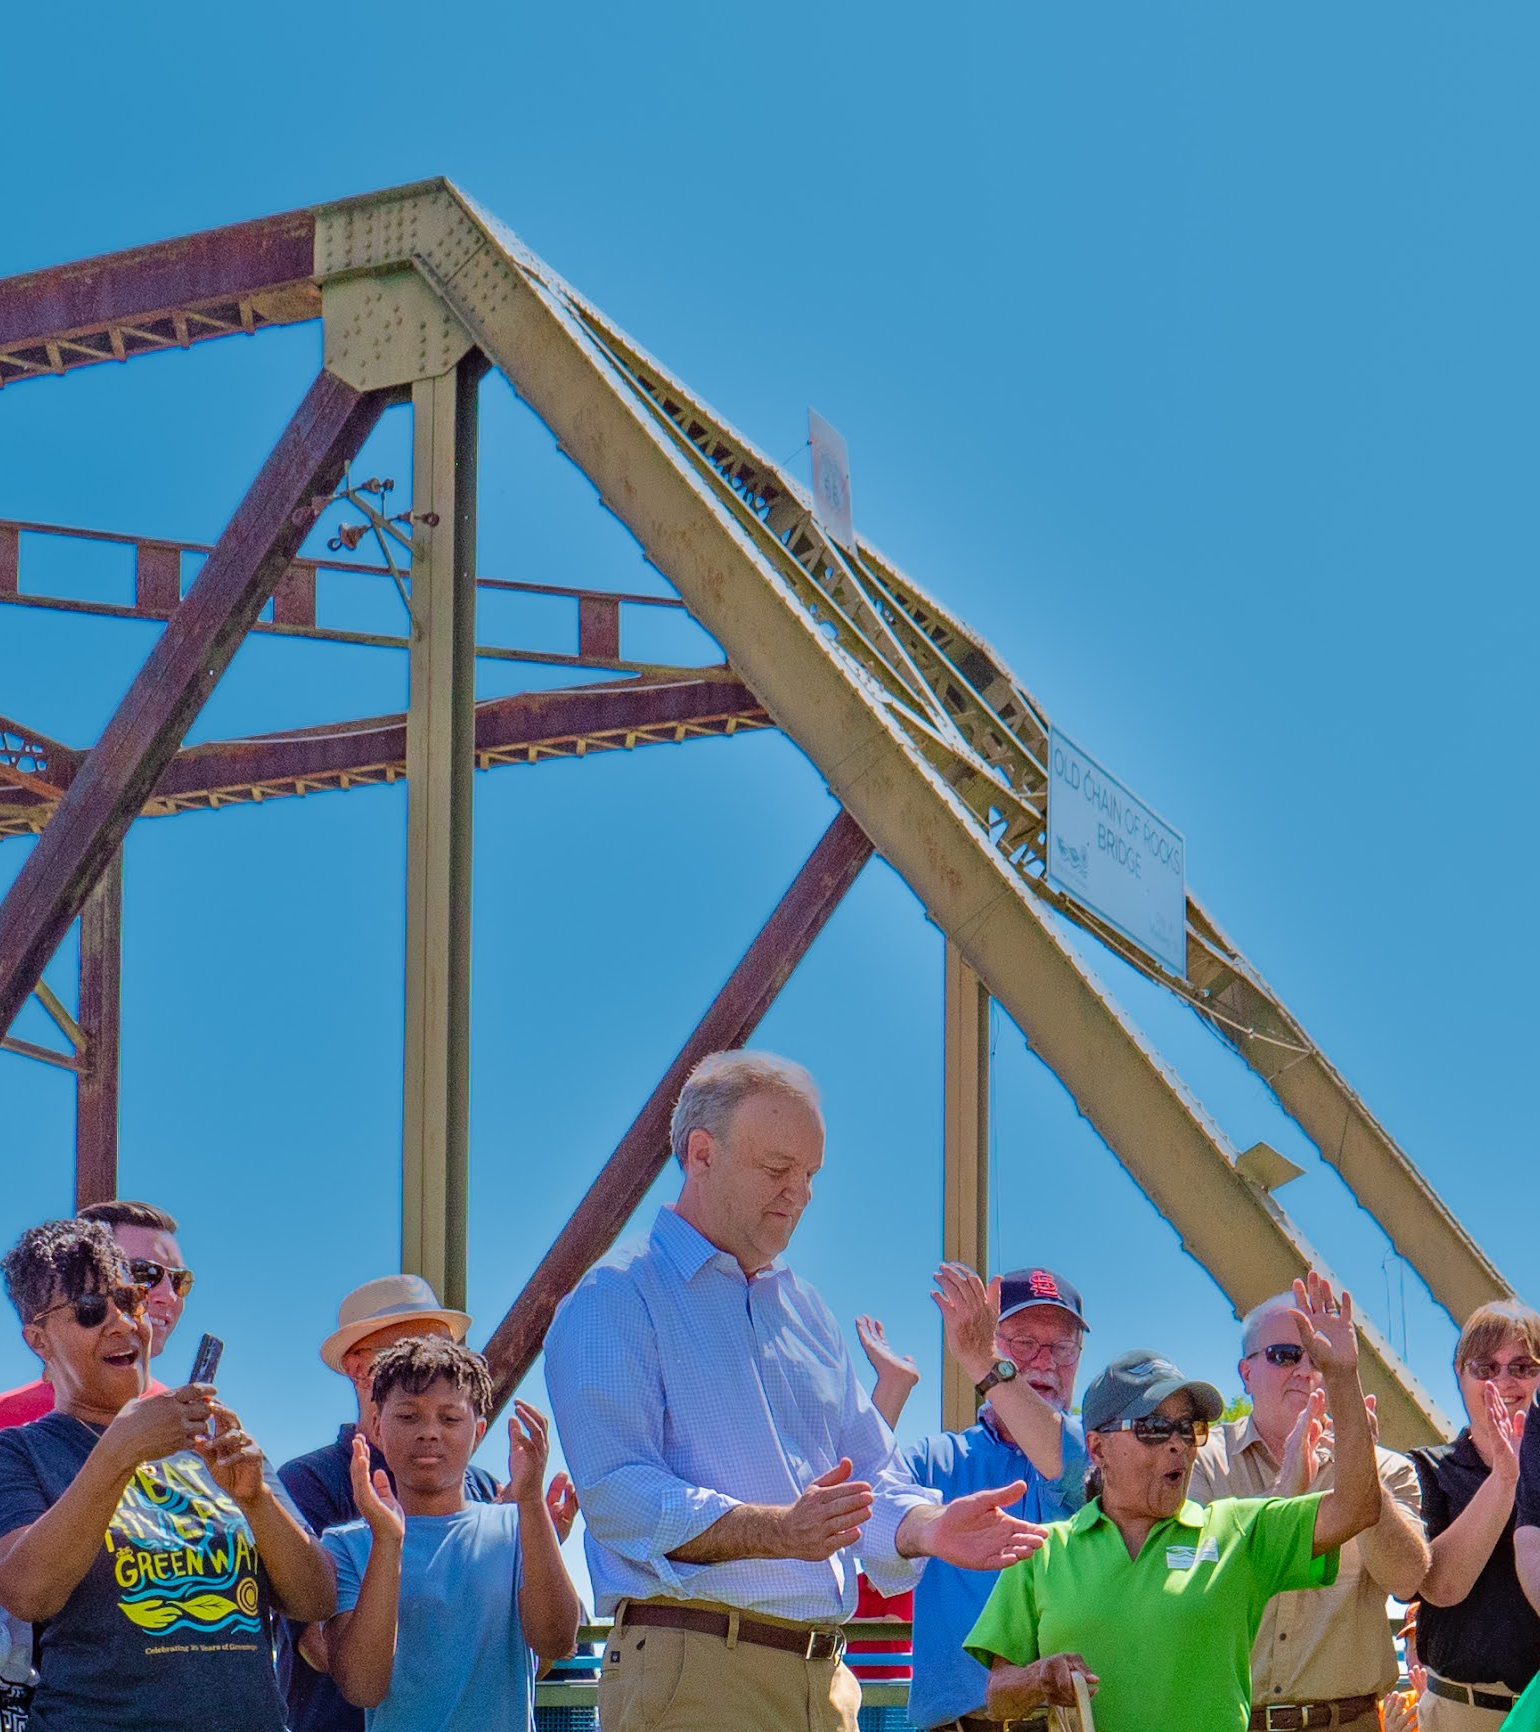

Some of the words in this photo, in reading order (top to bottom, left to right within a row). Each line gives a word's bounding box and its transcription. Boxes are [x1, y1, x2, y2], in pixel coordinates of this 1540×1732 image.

[1054, 748, 1080, 790] OLD
[1084, 770, 1122, 826] CHAIN
[1125, 808, 1141, 836] OF
[1144, 820, 1181, 876] ROCKS
[1098, 822, 1141, 880] BRIDGE
